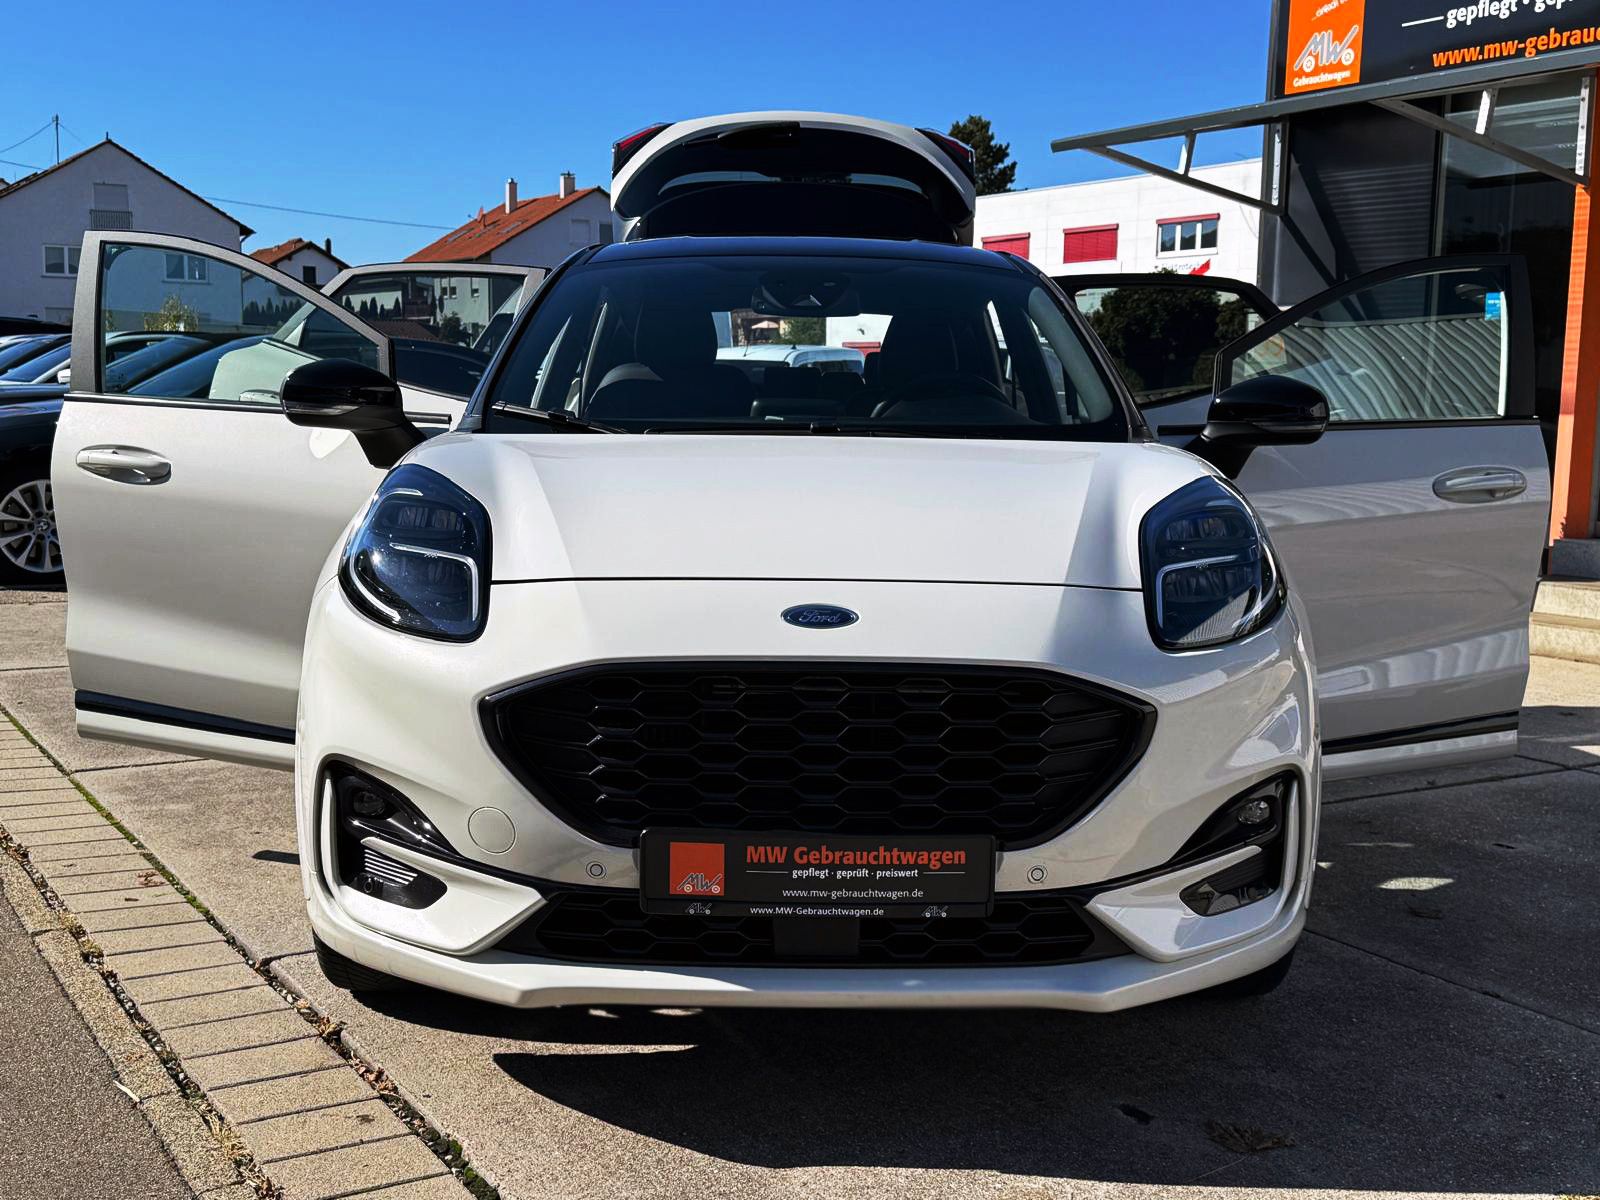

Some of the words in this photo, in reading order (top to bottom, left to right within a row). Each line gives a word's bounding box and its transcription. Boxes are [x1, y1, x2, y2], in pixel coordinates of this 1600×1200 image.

[1446, 0, 1518, 29] gepflegt
[1293, 71, 1351, 88] Gebrauchtwagen
[799, 609, 840, 623] Ford
[746, 845, 788, 864] MW
[794, 844, 966, 870] Gebrauchtwagen
[792, 867, 829, 879] gepflegt
[836, 868, 869, 880] geprüft
[876, 868, 918, 880] preiswert
[782, 888, 924, 900] www.mw-gebrauchtwagen.de
[750, 905, 884, 918] www.MW-Gebrauchtwagen.de
